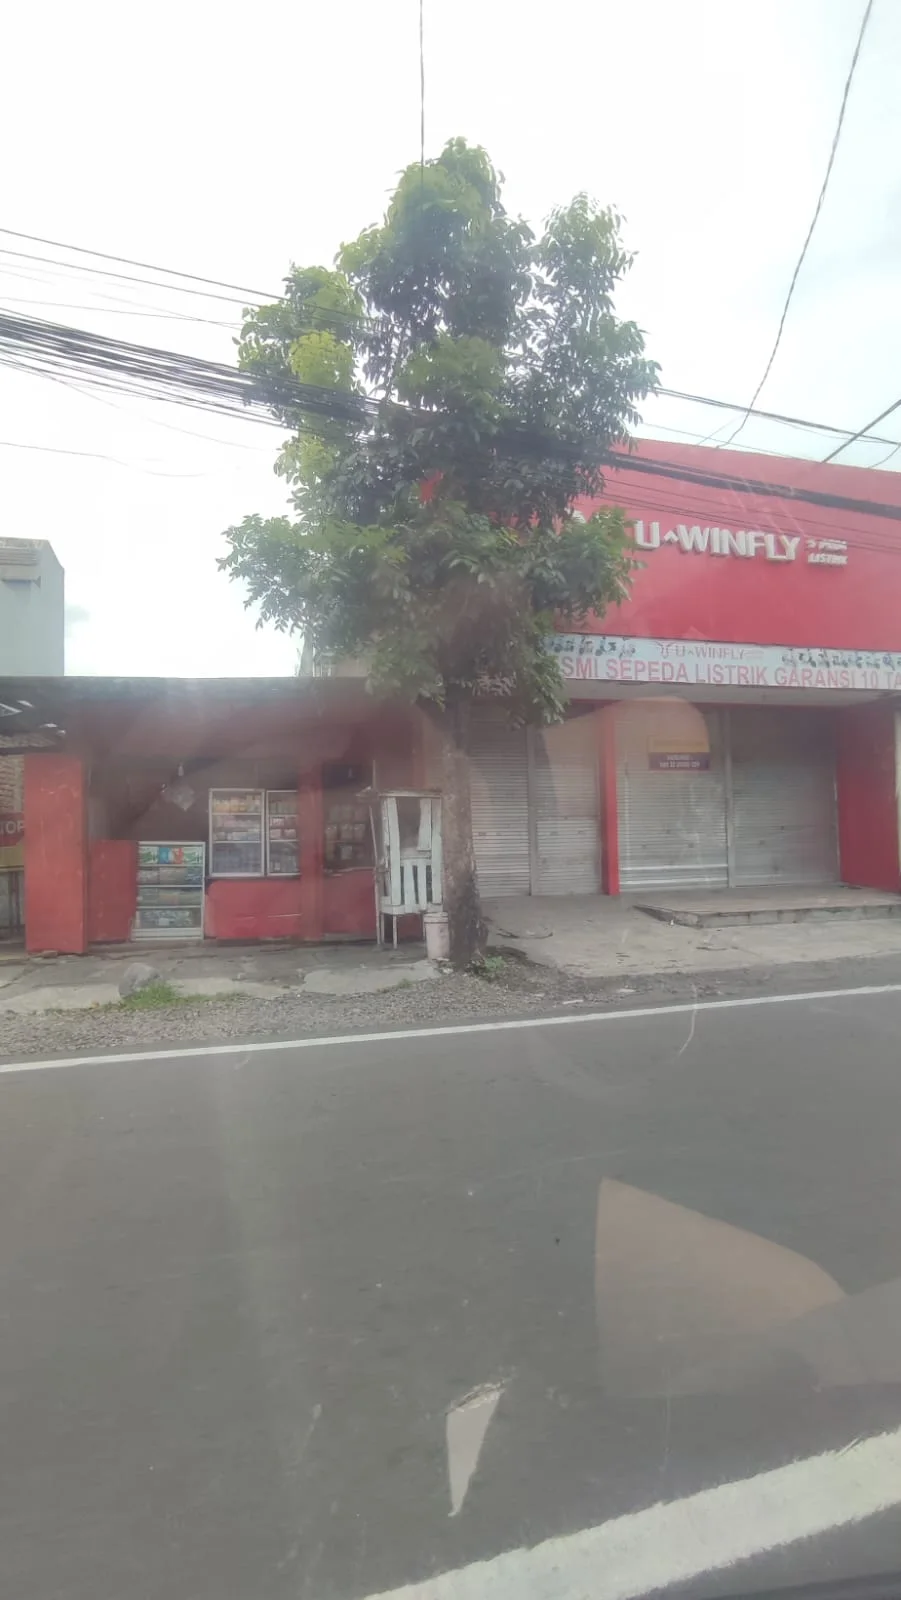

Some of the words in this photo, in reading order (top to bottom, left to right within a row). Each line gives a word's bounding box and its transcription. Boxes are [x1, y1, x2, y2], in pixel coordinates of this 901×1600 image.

[606, 659, 688, 681] SEPEDA
[696, 663, 767, 686] LISTRIK
[774, 667, 855, 689] GARANSI
[862, 670, 879, 689] 10
